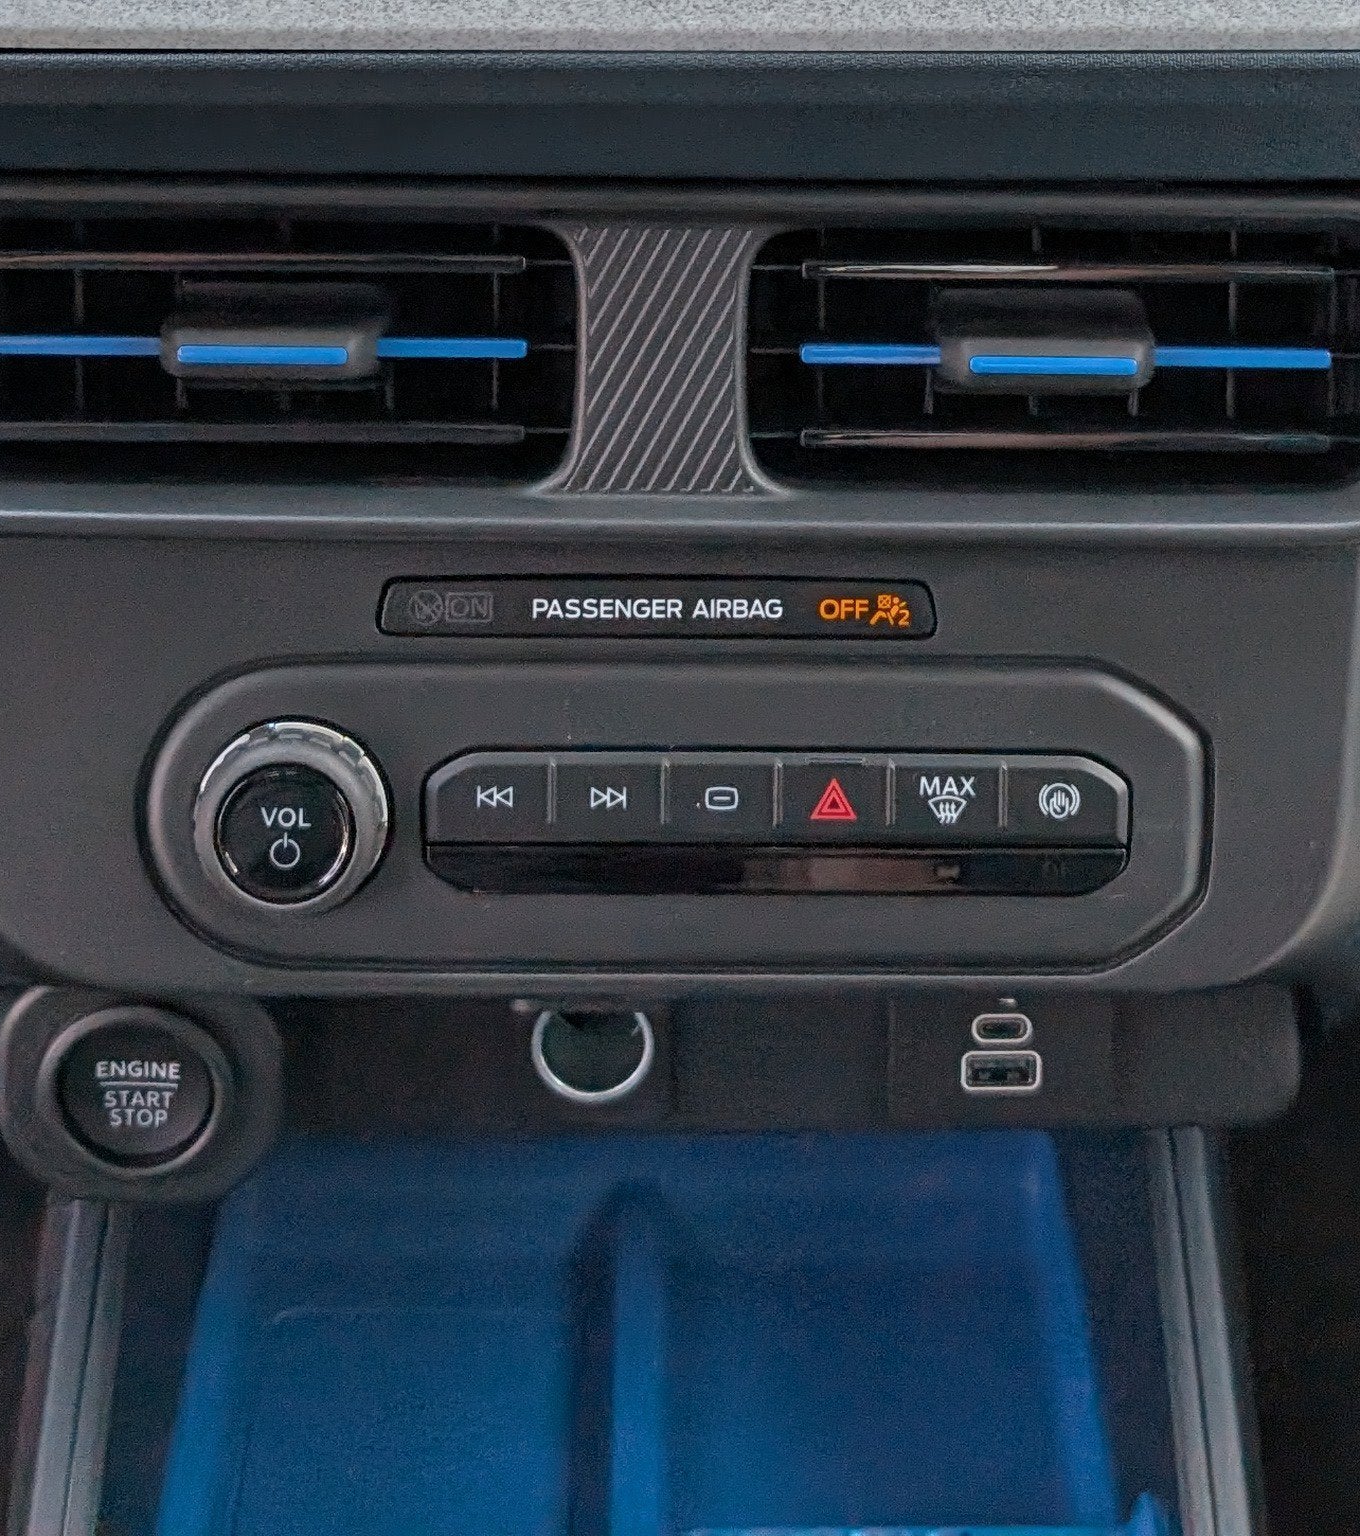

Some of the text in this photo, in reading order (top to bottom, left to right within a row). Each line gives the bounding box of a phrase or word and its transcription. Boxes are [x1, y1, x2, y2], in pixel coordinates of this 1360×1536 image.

[449, 596, 490, 618] ON
[532, 598, 784, 619] PASSENGER AIRBAG
[819, 598, 869, 620] OFF
[919, 776, 976, 797] MAX
[260, 807, 311, 828] VOL
[96, 1060, 180, 1080] ENGINE
[104, 1090, 173, 1109] START
[110, 1108, 168, 1127] STOP
